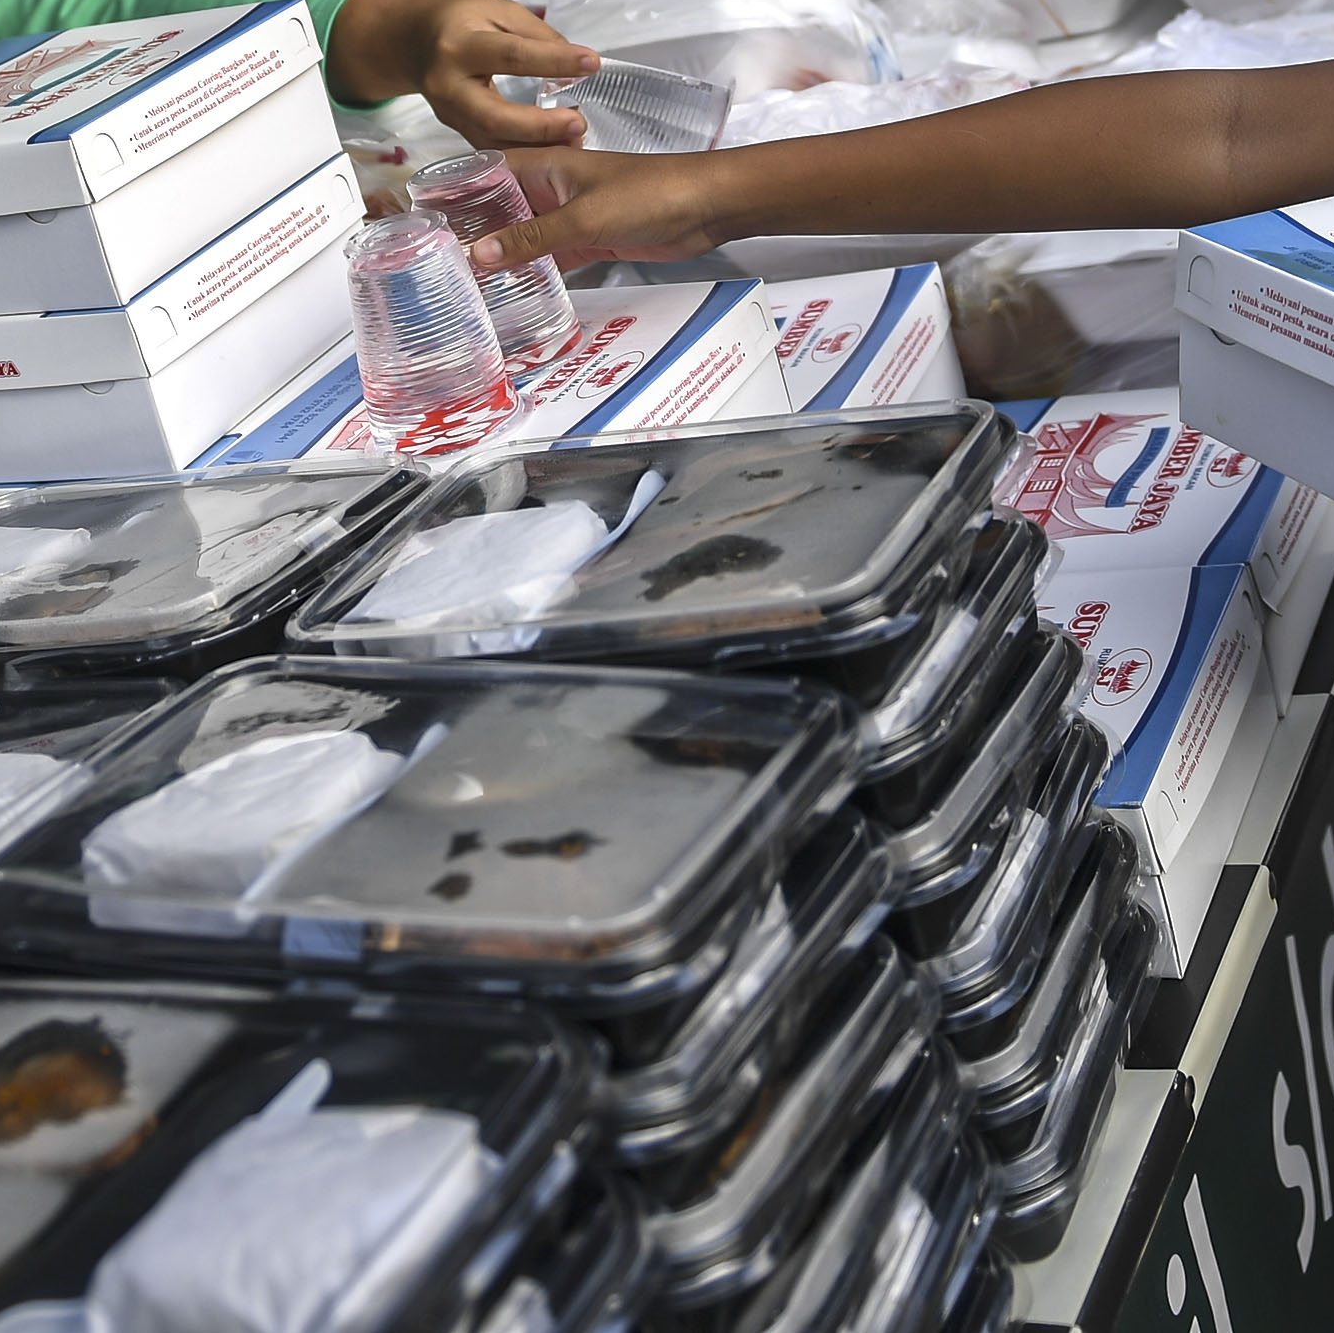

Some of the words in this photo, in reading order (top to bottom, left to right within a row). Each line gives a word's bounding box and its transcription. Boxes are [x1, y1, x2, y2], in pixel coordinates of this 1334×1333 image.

[1232, 303, 1269, 327] Menerima
[1269, 322, 1301, 342] pesanan
[1236, 289, 1259, 308] Untuk
[1260, 303, 1281, 318] acara
[1282, 312, 1304, 329] pesta,
[1306, 323, 1328, 338] acara
[1264, 287, 1300, 310] Melayani
[1300, 305, 1333, 325] pesanan
[1154, 423, 1205, 480] MBER
[1127, 481, 1179, 534] JAYA
[1068, 601, 1110, 650] SUM
